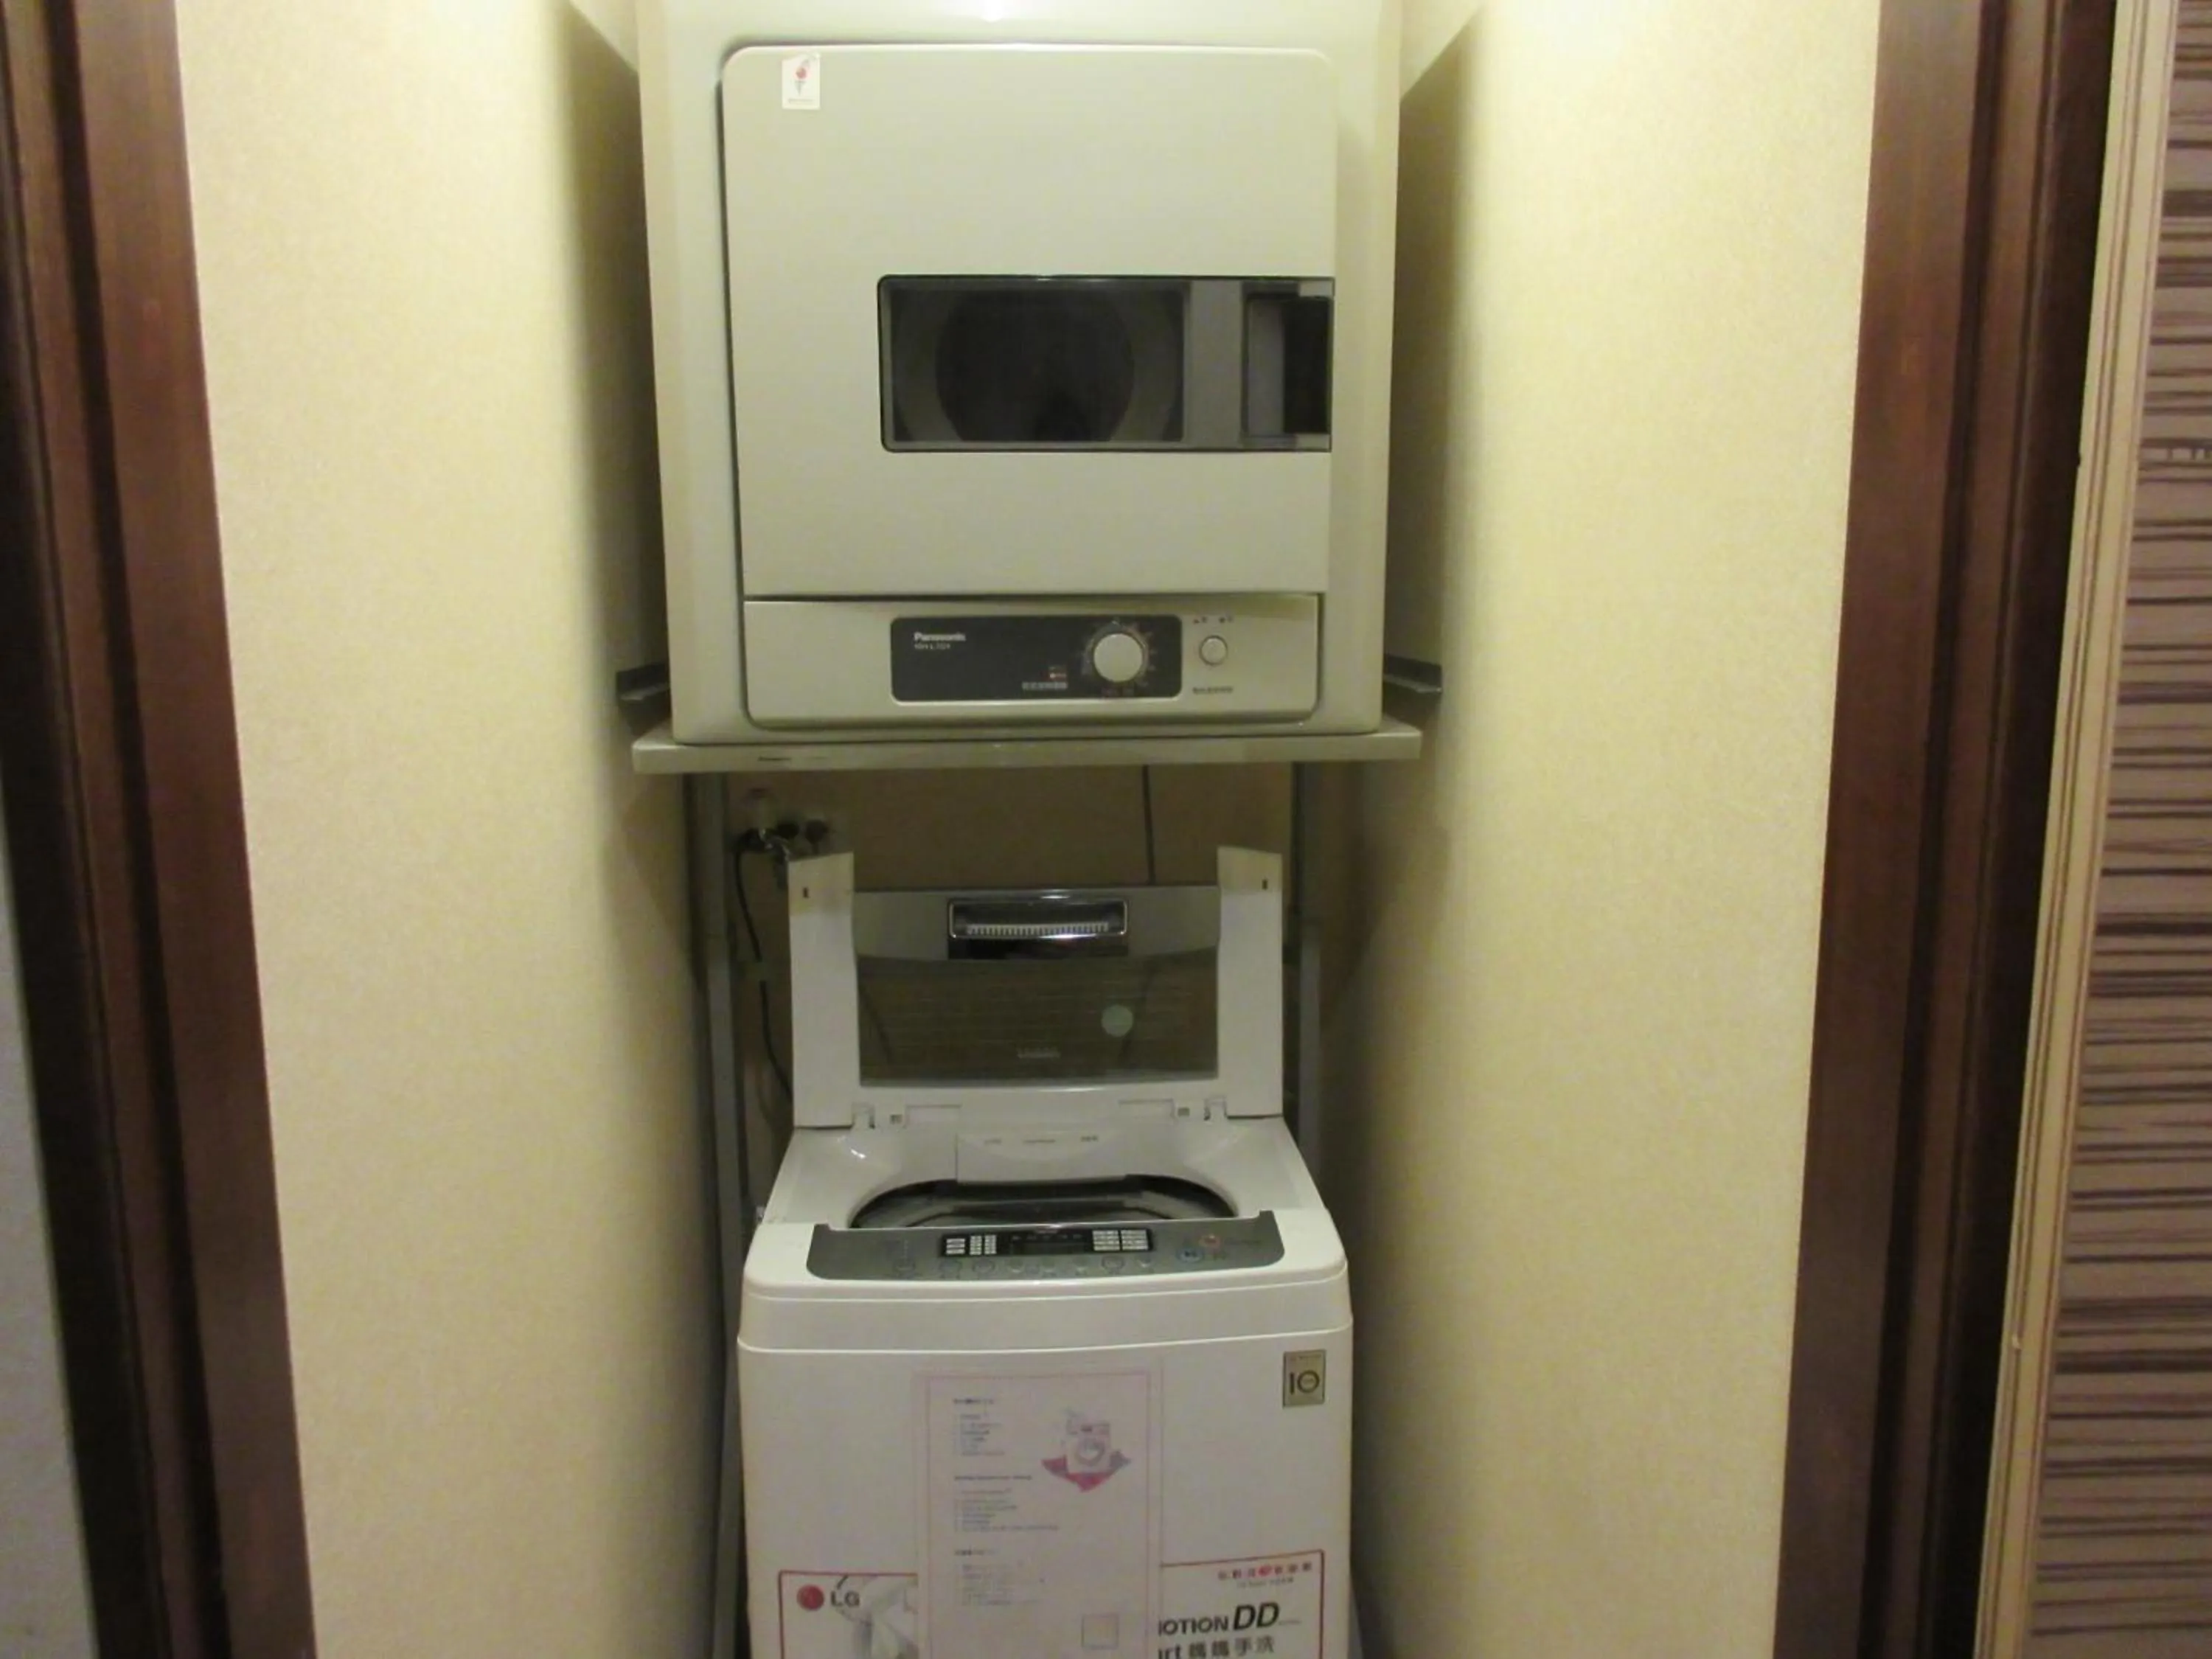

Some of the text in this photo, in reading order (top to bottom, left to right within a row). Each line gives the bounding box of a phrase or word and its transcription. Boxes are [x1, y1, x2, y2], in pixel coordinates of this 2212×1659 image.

[831, 1590, 860, 1607] LG
[1158, 1601, 1281, 1636] OTION DD
